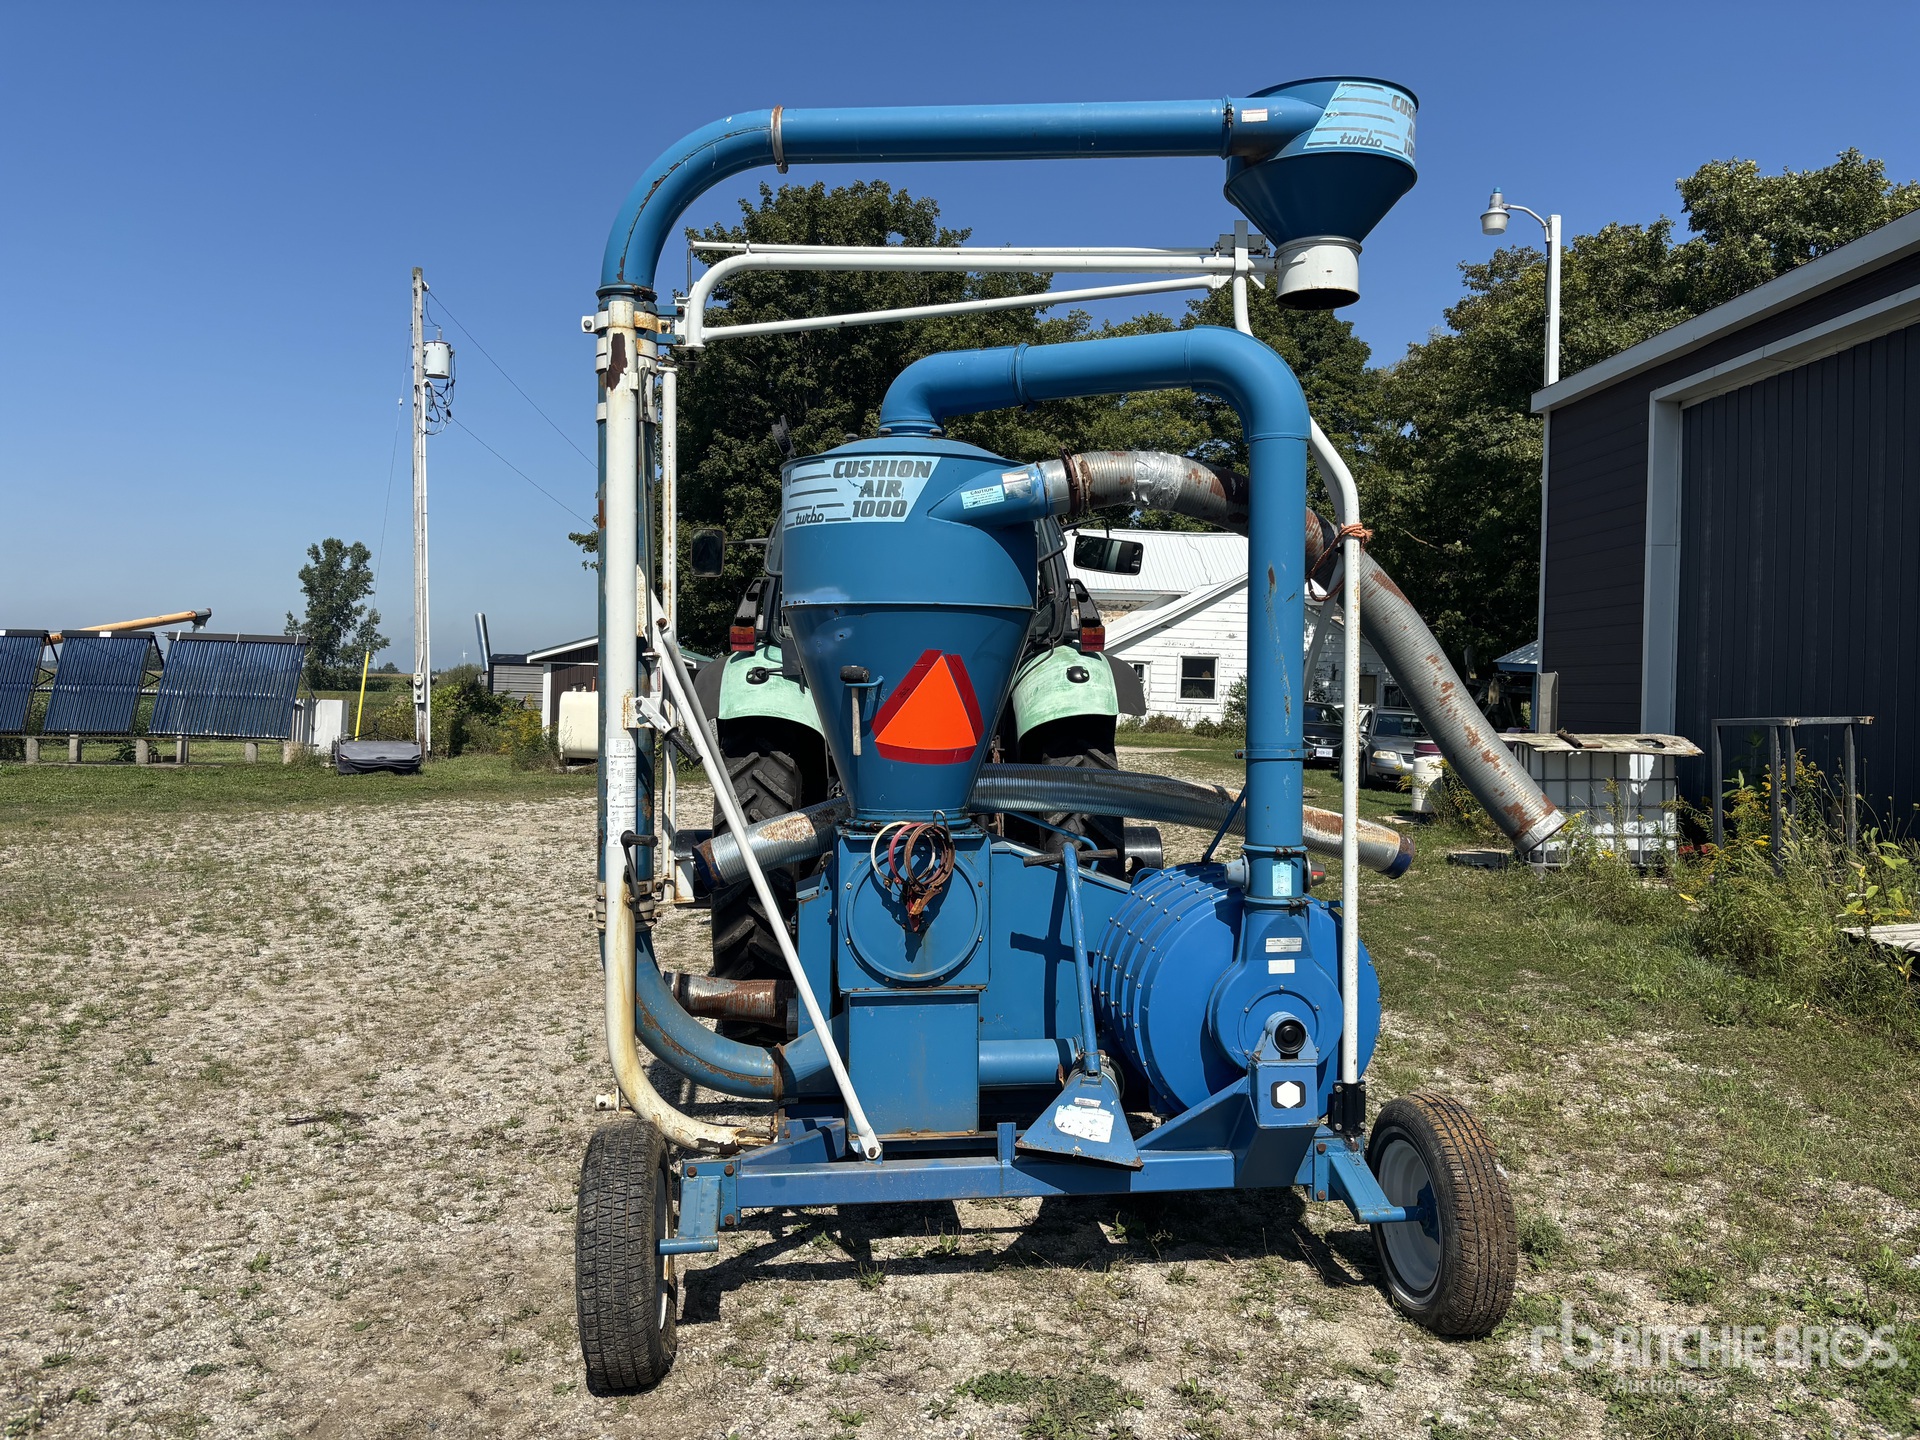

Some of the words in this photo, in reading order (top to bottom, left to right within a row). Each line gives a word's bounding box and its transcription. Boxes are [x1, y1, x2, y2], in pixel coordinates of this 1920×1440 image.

[1340, 129, 1382, 147] turbo
[833, 460, 932, 478] CUSHION
[859, 480, 902, 497] AIR
[970, 487, 993, 496] CAUTION
[795, 506, 825, 525] turbo
[852, 500, 907, 518] 1000
